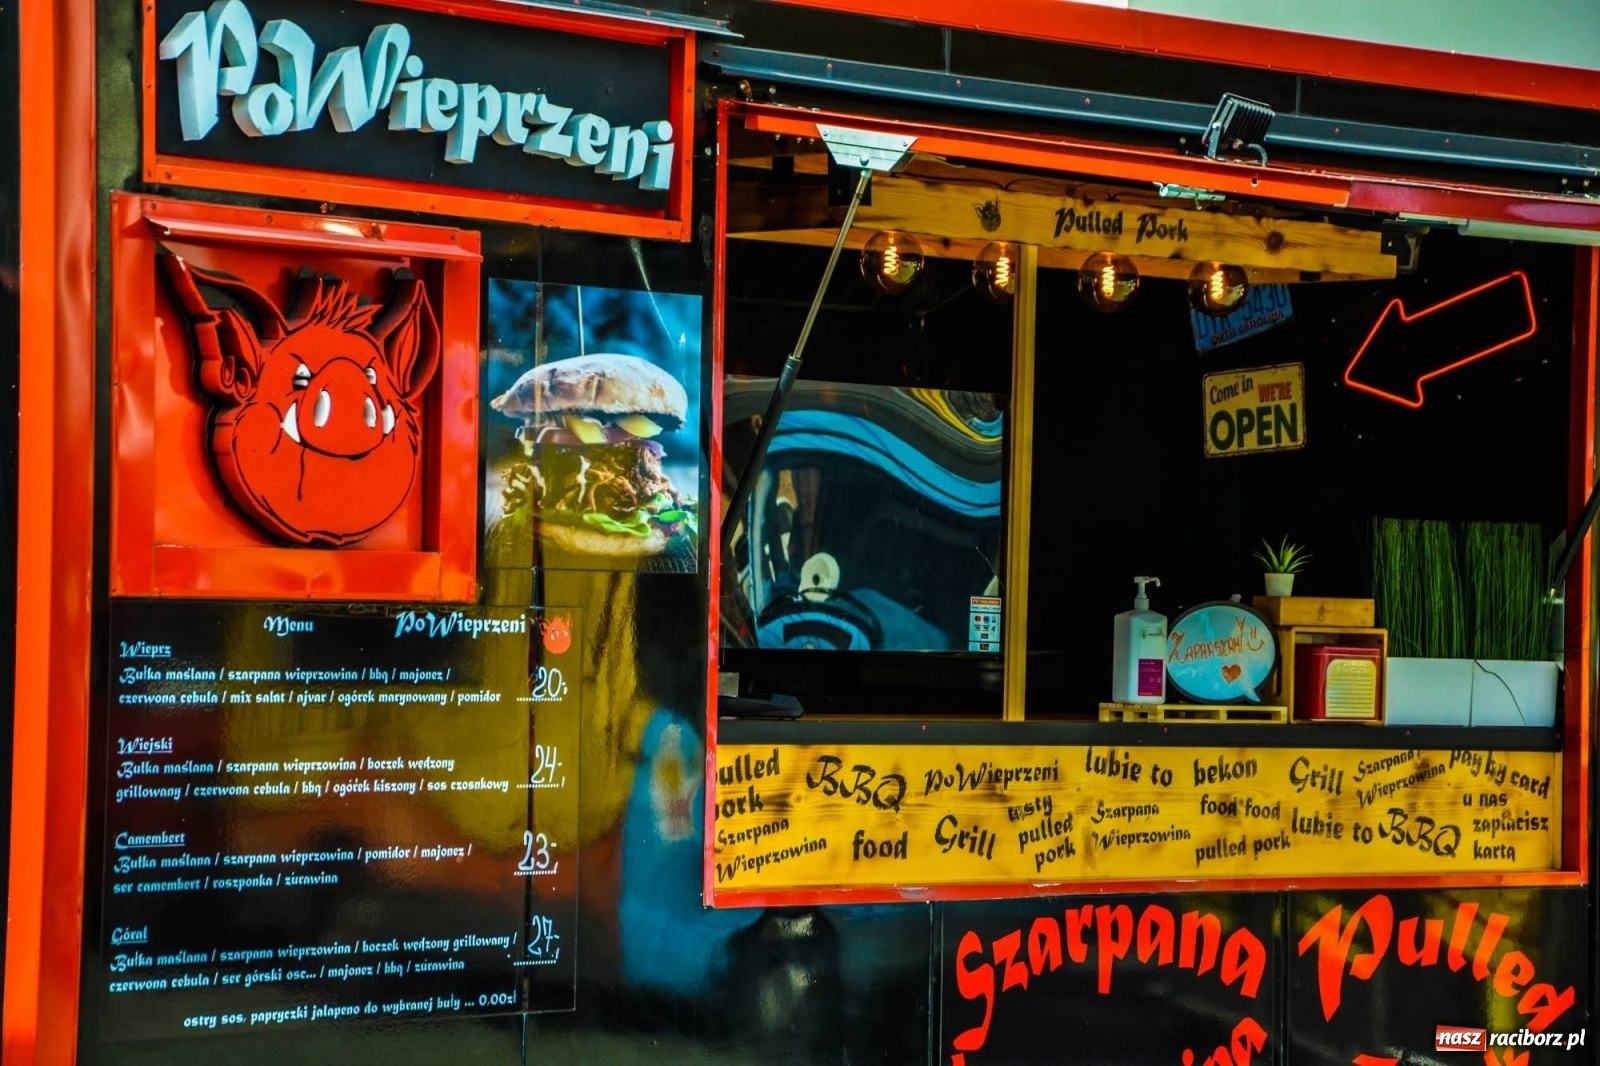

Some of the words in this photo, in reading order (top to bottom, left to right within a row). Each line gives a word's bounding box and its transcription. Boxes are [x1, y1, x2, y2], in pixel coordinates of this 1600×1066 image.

[159, 0, 675, 190] PoWieprzeni
[1054, 206, 1123, 239] Pulled
[1136, 213, 1189, 243] Pork
[1210, 381, 1240, 405] Come
[1242, 374, 1254, 393] in
[1257, 381, 1292, 403] WE'RE
[1210, 402, 1298, 451] OPEN
[264, 616, 313, 637] Menu
[395, 611, 526, 639] PoWieprzeni
[120, 642, 171, 657] Wieprz
[166, 668, 216, 680] maślana
[228, 670, 280, 684] szarpana
[286, 668, 358, 684] wieprzowina
[370, 668, 388, 683] bbq
[400, 669, 443, 684] majonez
[119, 693, 175, 704] czerwona
[230, 691, 251, 704] mix
[297, 691, 326, 706] ajvar
[338, 690, 374, 706] ogórek
[379, 692, 446, 706] marynowany
[458, 690, 501, 705] pomidor
[118, 738, 173, 754] Wiejski
[164, 760, 213, 774] maślana
[226, 761, 279, 775] szarpana
[284, 758, 356, 774] wieprzowina
[368, 757, 403, 770] boczek
[716, 748, 780, 787] ulled
[924, 759, 1058, 797] PoWieprzeni
[1151, 764, 1173, 787] to
[1193, 755, 1258, 787] bekon
[1289, 755, 1344, 797] Grill
[1353, 749, 1414, 782] Szarpana
[1449, 749, 1482, 777] pay
[1484, 751, 1508, 786] by
[1510, 768, 1551, 799] card
[116, 785, 181, 800] grillowany
[194, 786, 249, 797] czerwona
[302, 781, 321, 797] bbq
[333, 779, 370, 796] ogórek
[374, 780, 416, 794] kiszony
[427, 781, 446, 791] sos
[451, 778, 509, 792] czosnkowy
[806, 755, 907, 814] BBQ
[1356, 763, 1446, 809] Wieprzowina
[1462, 792, 1473, 807] u
[1479, 791, 1508, 807] nas
[715, 785, 764, 821] ork
[1090, 800, 1159, 824] Szarpana
[1200, 793, 1238, 817] food
[1244, 798, 1281, 821] food
[115, 831, 185, 850] Camembert
[714, 818, 789, 853] Szarpana
[852, 829, 908, 862] food
[934, 814, 996, 860] Grill
[1018, 811, 1073, 854] pulled
[1091, 824, 1191, 850] Wieprzowina
[1353, 822, 1373, 844] to
[1378, 808, 1462, 858] BBQ
[161, 853, 211, 867] maślana
[224, 854, 276, 868] szarpana
[281, 849, 354, 865] wieprzowina
[365, 847, 410, 863] pomidor
[421, 845, 464, 861] majonez
[715, 837, 827, 883] Wieprzowina
[1035, 836, 1076, 873] pork
[1195, 834, 1247, 869] pulled
[1253, 829, 1291, 860] pork
[113, 882, 133, 893] ser
[137, 878, 200, 891] camembert
[213, 874, 273, 891] roszponka
[111, 926, 148, 945] Góral
[157, 951, 207, 965] maślana
[220, 950, 273, 964] szarpana
[278, 944, 350, 960] wieprzowina
[362, 939, 399, 953] boczek
[453, 935, 509, 951] grillowany
[110, 980, 167, 992] czerwona
[222, 973, 241, 984] ser
[328, 964, 373, 980] majonez
[385, 960, 403, 976] bbq
[953, 903, 1266, 1051] Szarpana
[1298, 894, 1576, 1034] Pulled
[184, 1013, 217, 1029] ostry
[251, 1006, 307, 1027] papryczki
[364, 1002, 378, 1013] do
[383, 998, 432, 1016] wybranej
